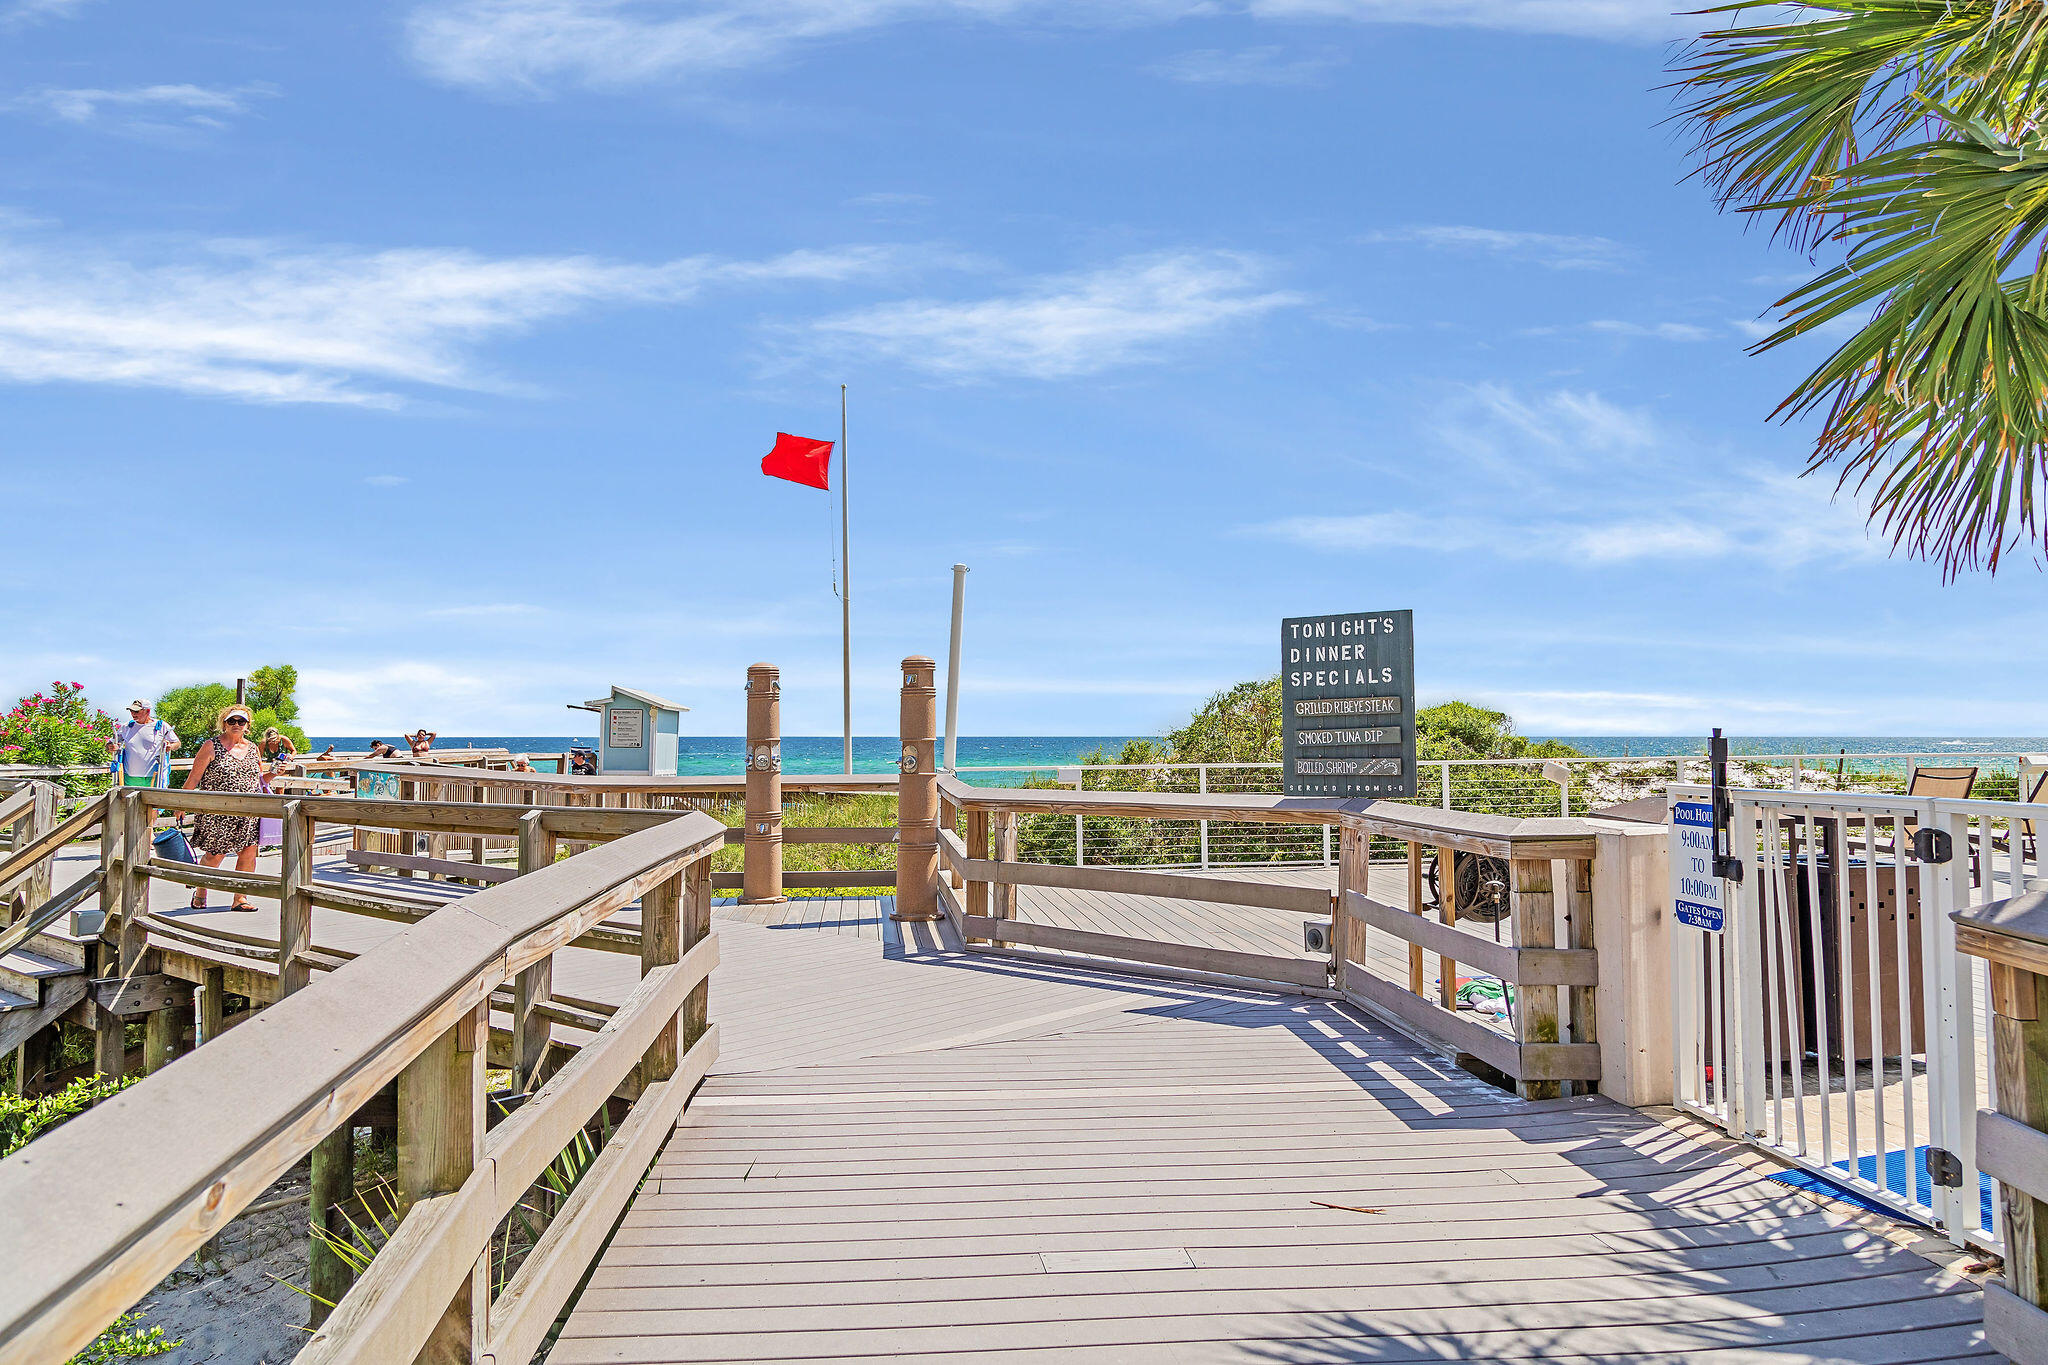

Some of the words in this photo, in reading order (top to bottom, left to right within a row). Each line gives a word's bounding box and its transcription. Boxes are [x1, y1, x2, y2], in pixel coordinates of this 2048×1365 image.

[1291, 616, 1394, 639] TONIGHT'S
[1290, 644, 1365, 663] DINNER
[1291, 667, 1393, 687] SPECIALS
[1295, 702, 1332, 715] GRILLED
[1334, 700, 1364, 714] RIBEYE
[1365, 699, 1394, 712] STEAK
[1298, 730, 1333, 745] SMOKED
[1335, 731, 1361, 743] TUNA
[1364, 730, 1383, 742] DIP
[1297, 761, 1324, 774] BOILED
[1326, 761, 1358, 774] SHRIMP
[1289, 784, 1337, 792] SERVED
[1347, 784, 1380, 792] FROM
[1675, 806, 1695, 821] POOL
[1695, 808, 1713, 823] HOU
[1691, 857, 1705, 874] TO
[1681, 877, 1718, 900] 10:00PM
[1678, 901, 1701, 916] GATES
[1701, 906, 1722, 920] OPEN
